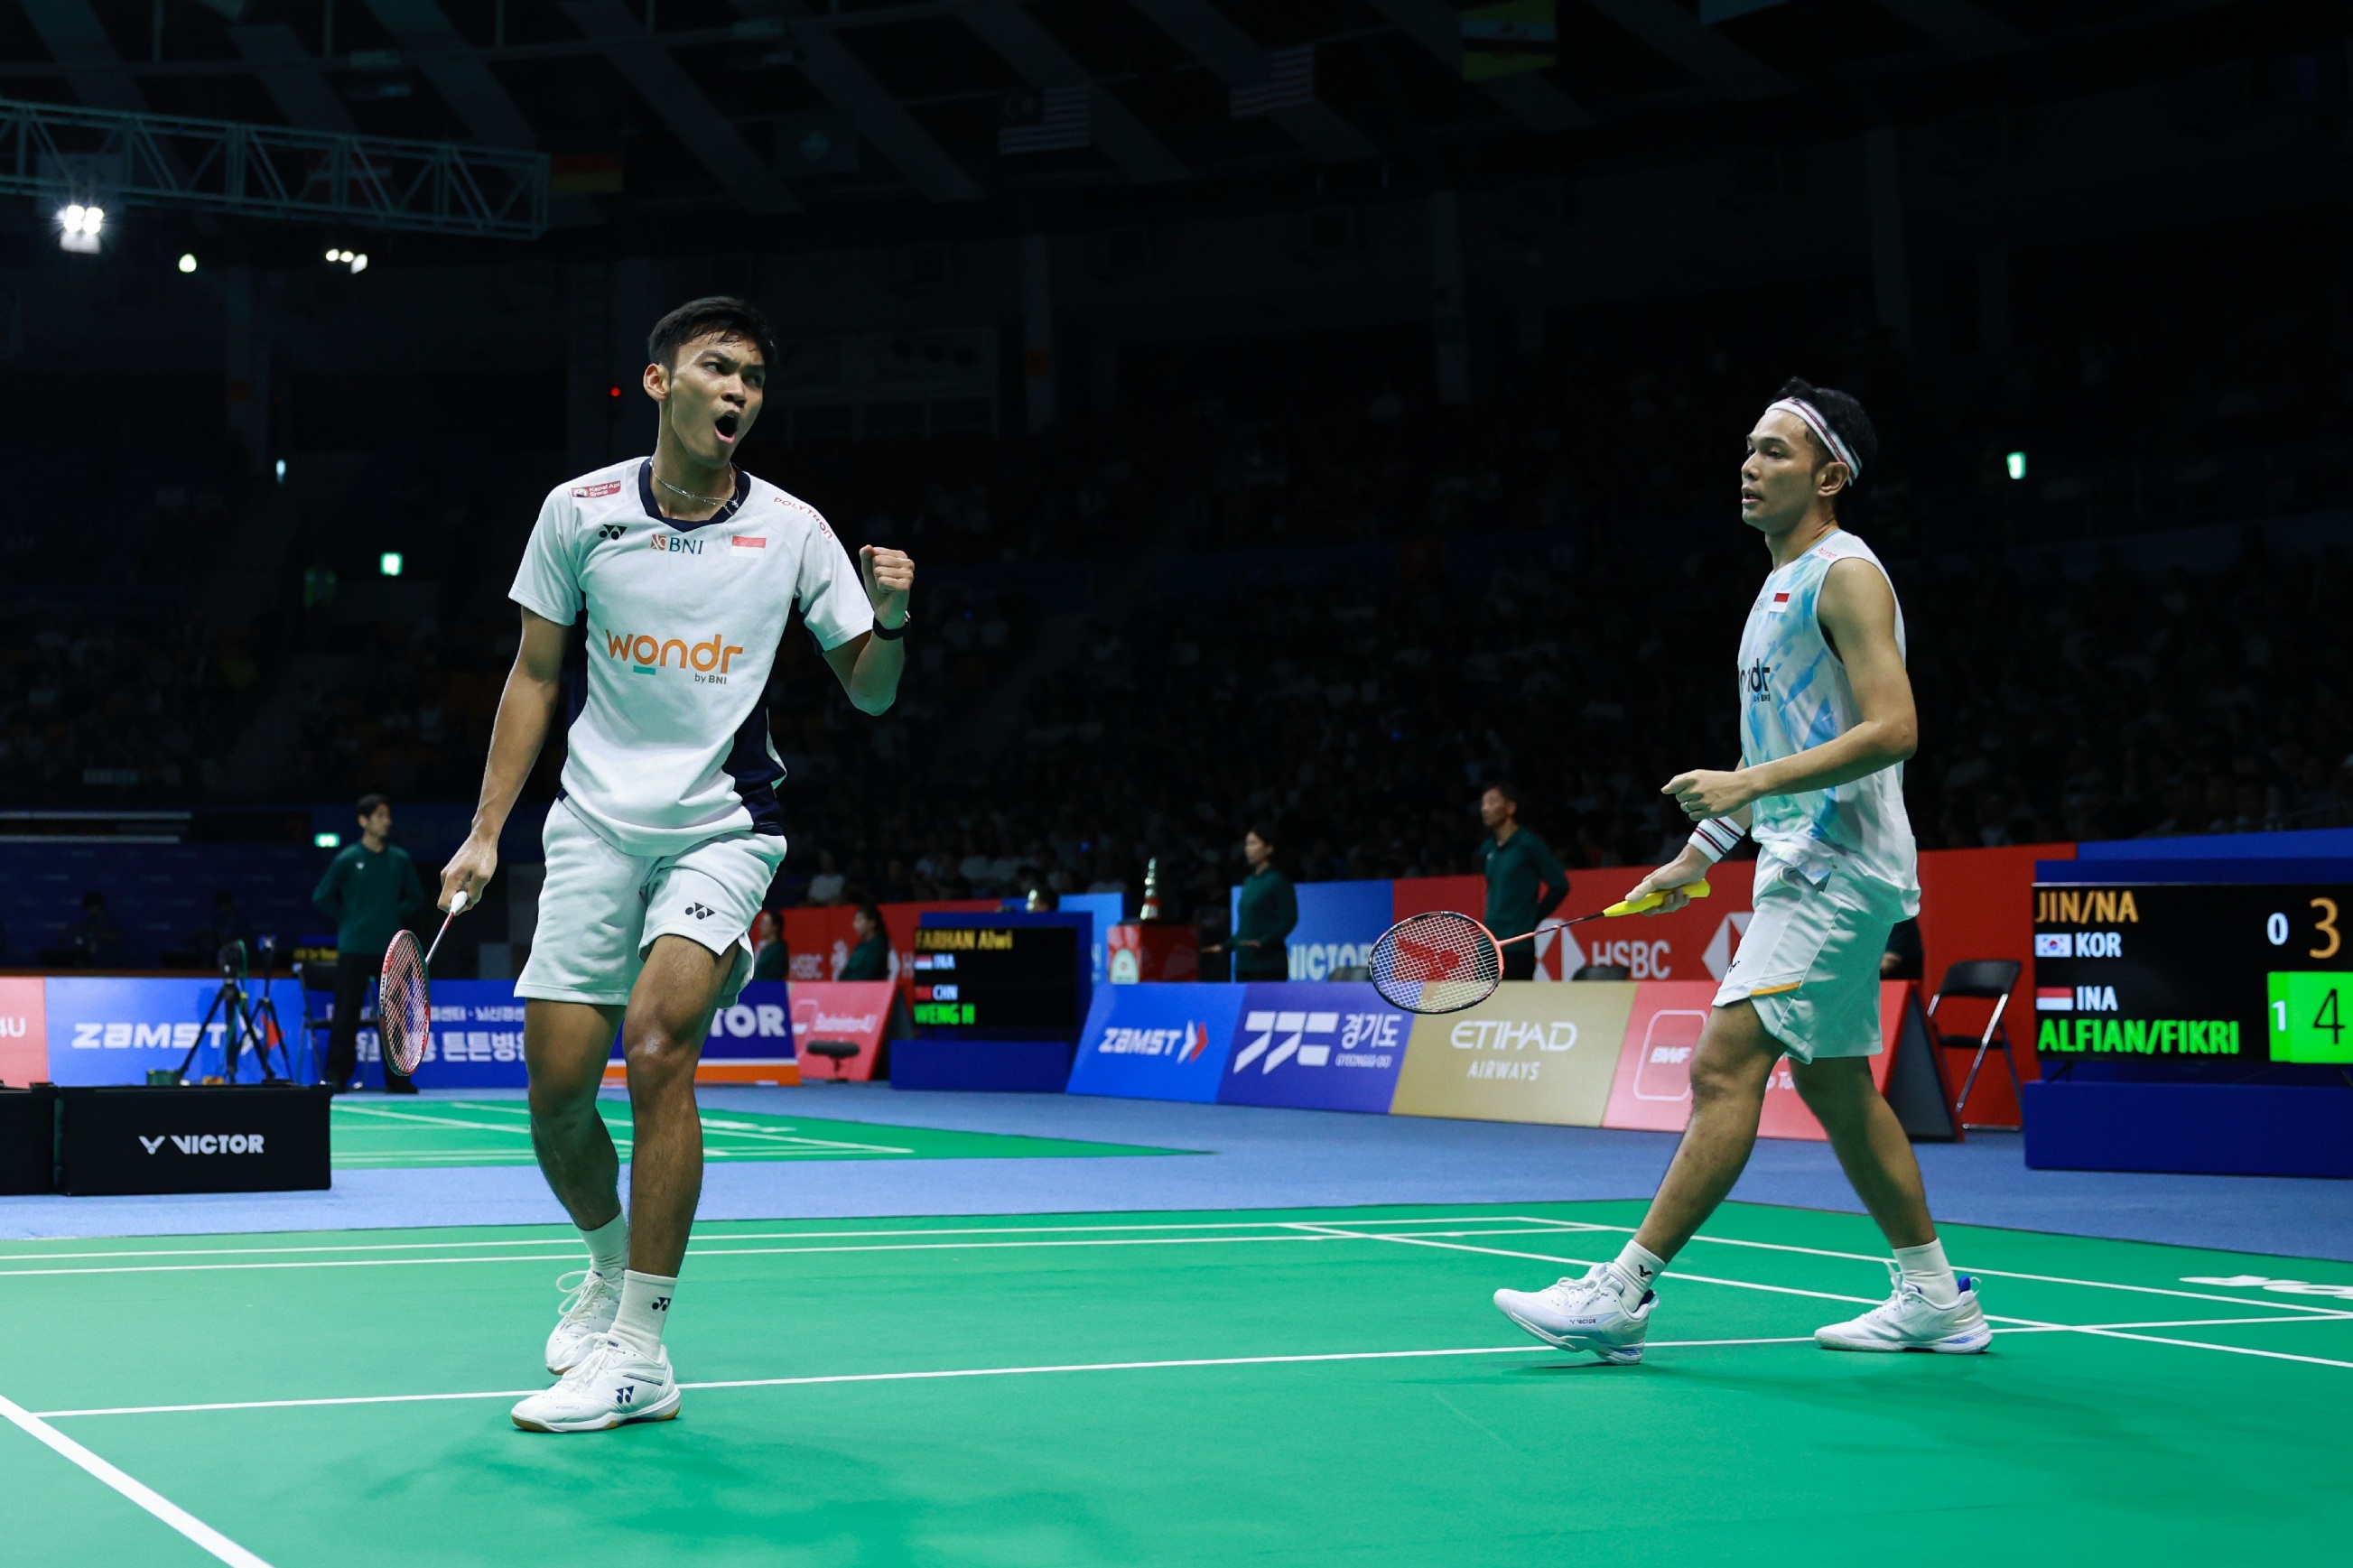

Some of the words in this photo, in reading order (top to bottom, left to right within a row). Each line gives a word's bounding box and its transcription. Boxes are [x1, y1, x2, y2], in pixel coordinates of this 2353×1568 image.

[669, 537, 704, 555] BNI
[605, 629, 743, 673] wondr
[694, 673, 706, 683] by
[708, 675, 727, 684] BNI
[2034, 891, 2139, 924] JIN/NA
[2267, 913, 2289, 945] 0
[2309, 897, 2341, 959] 3
[1592, 940, 1670, 979] HSBC
[2075, 932, 2122, 958] KOR
[2076, 986, 2118, 1012] INA
[2271, 1000, 2287, 1032] 1
[2312, 988, 2347, 1045] 4
[70, 1022, 228, 1050] ZAMST
[1098, 1027, 1183, 1056] ZAMST
[1341, 1013, 1404, 1050] 경기도
[1449, 1020, 1577, 1052] ETIHAD
[2037, 1018, 2240, 1055] ALFIAN/FIKRI
[1650, 1045, 1692, 1064] BWF
[1466, 1059, 1541, 1082] AIRWAYS
[171, 1134, 265, 1155] VICTOR
